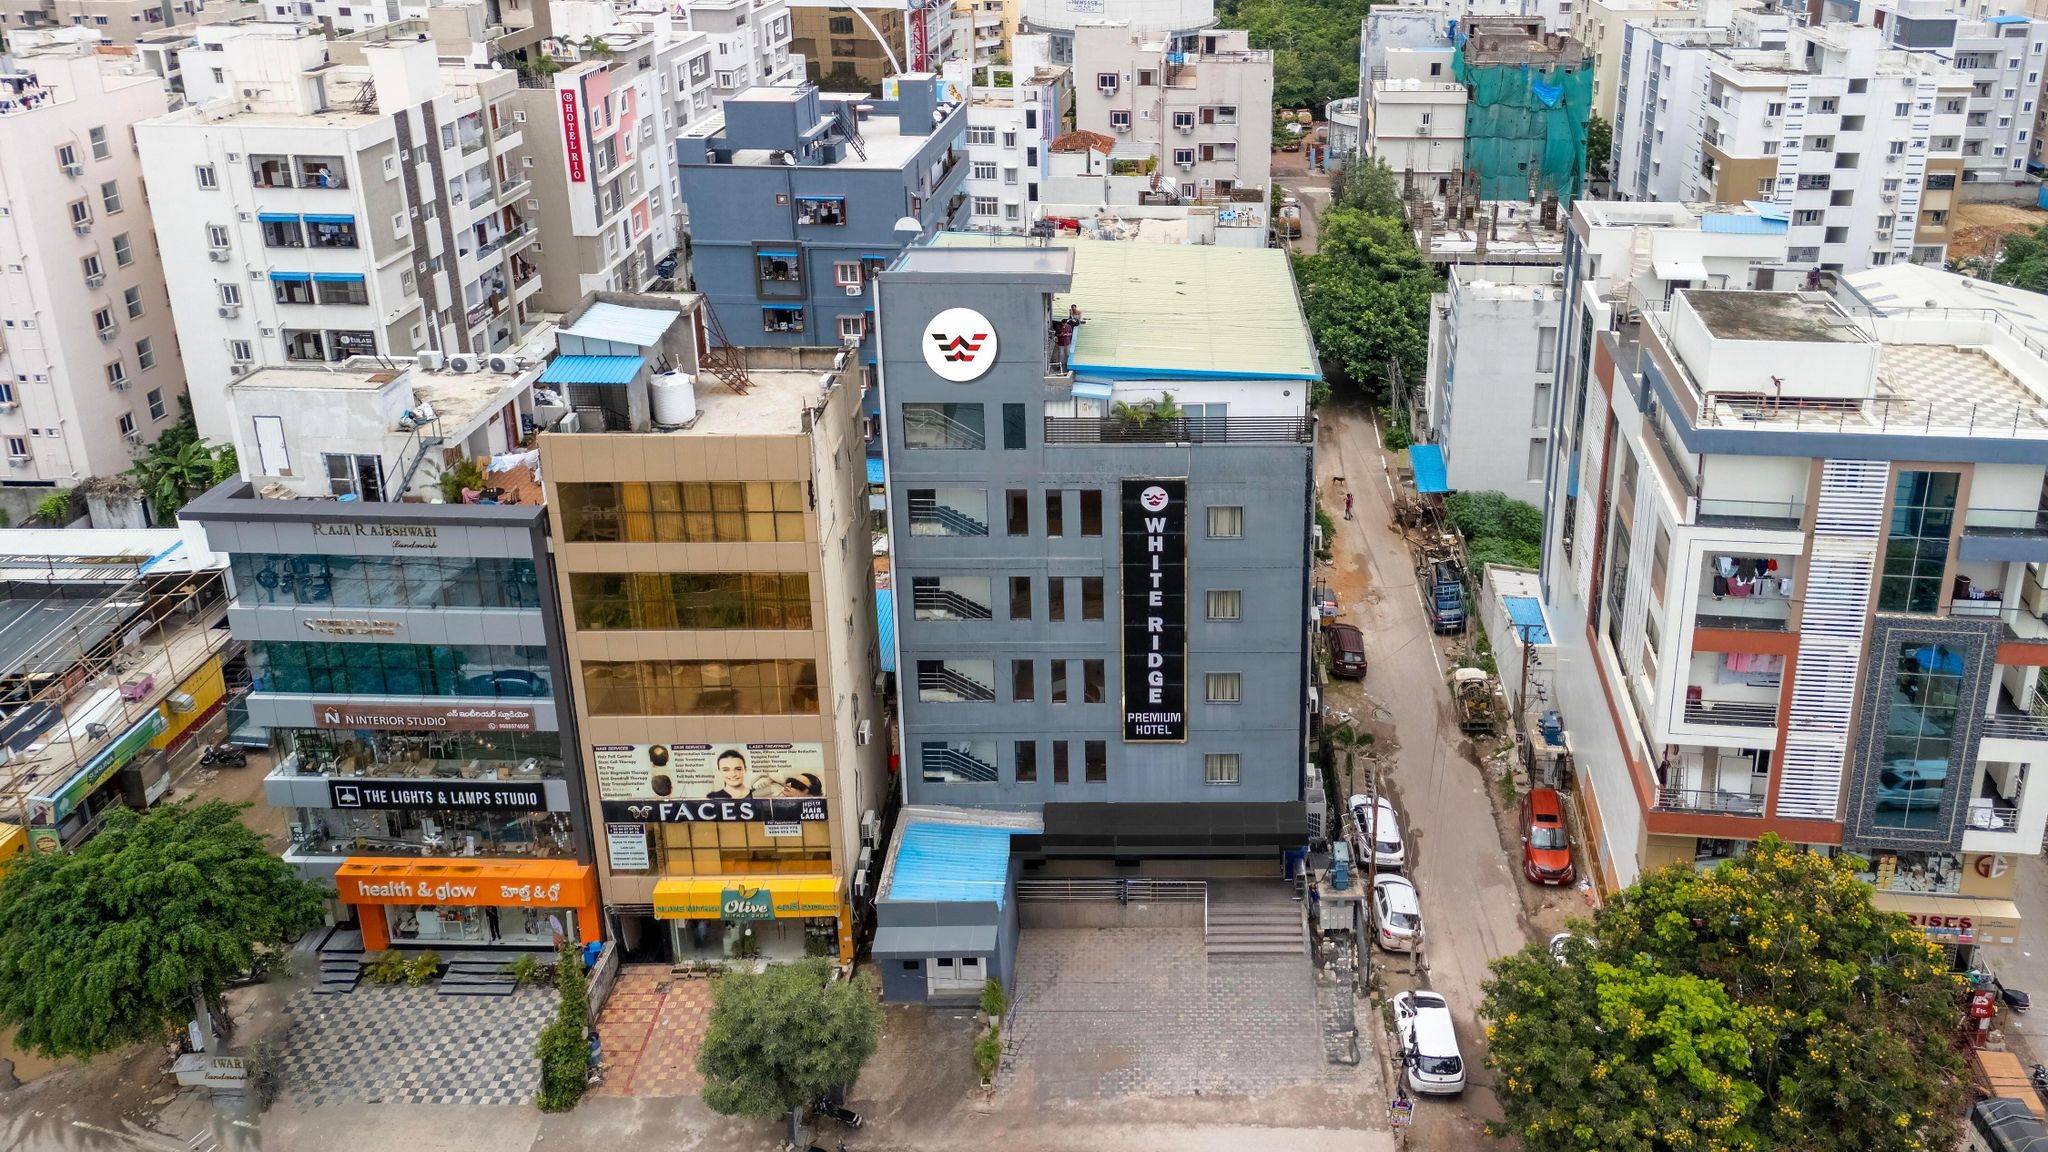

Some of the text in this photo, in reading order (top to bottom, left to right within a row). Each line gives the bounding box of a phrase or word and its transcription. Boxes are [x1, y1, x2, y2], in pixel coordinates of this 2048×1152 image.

[565, 103, 581, 180] HOTEL RIO
[1144, 517, 1166, 704] WHITE RIDGE
[346, 715, 447, 727] N INTERIOR STUDIO
[1127, 712, 1181, 723] PREMIUM
[1135, 724, 1172, 735] HOTEL
[364, 789, 538, 806] THE LIGHTS & LAMPS STUDIO
[659, 801, 755, 822] FACES
[358, 880, 477, 901] health & glow
[534, 885, 547, 898] &
[724, 899, 768, 914] Olive
